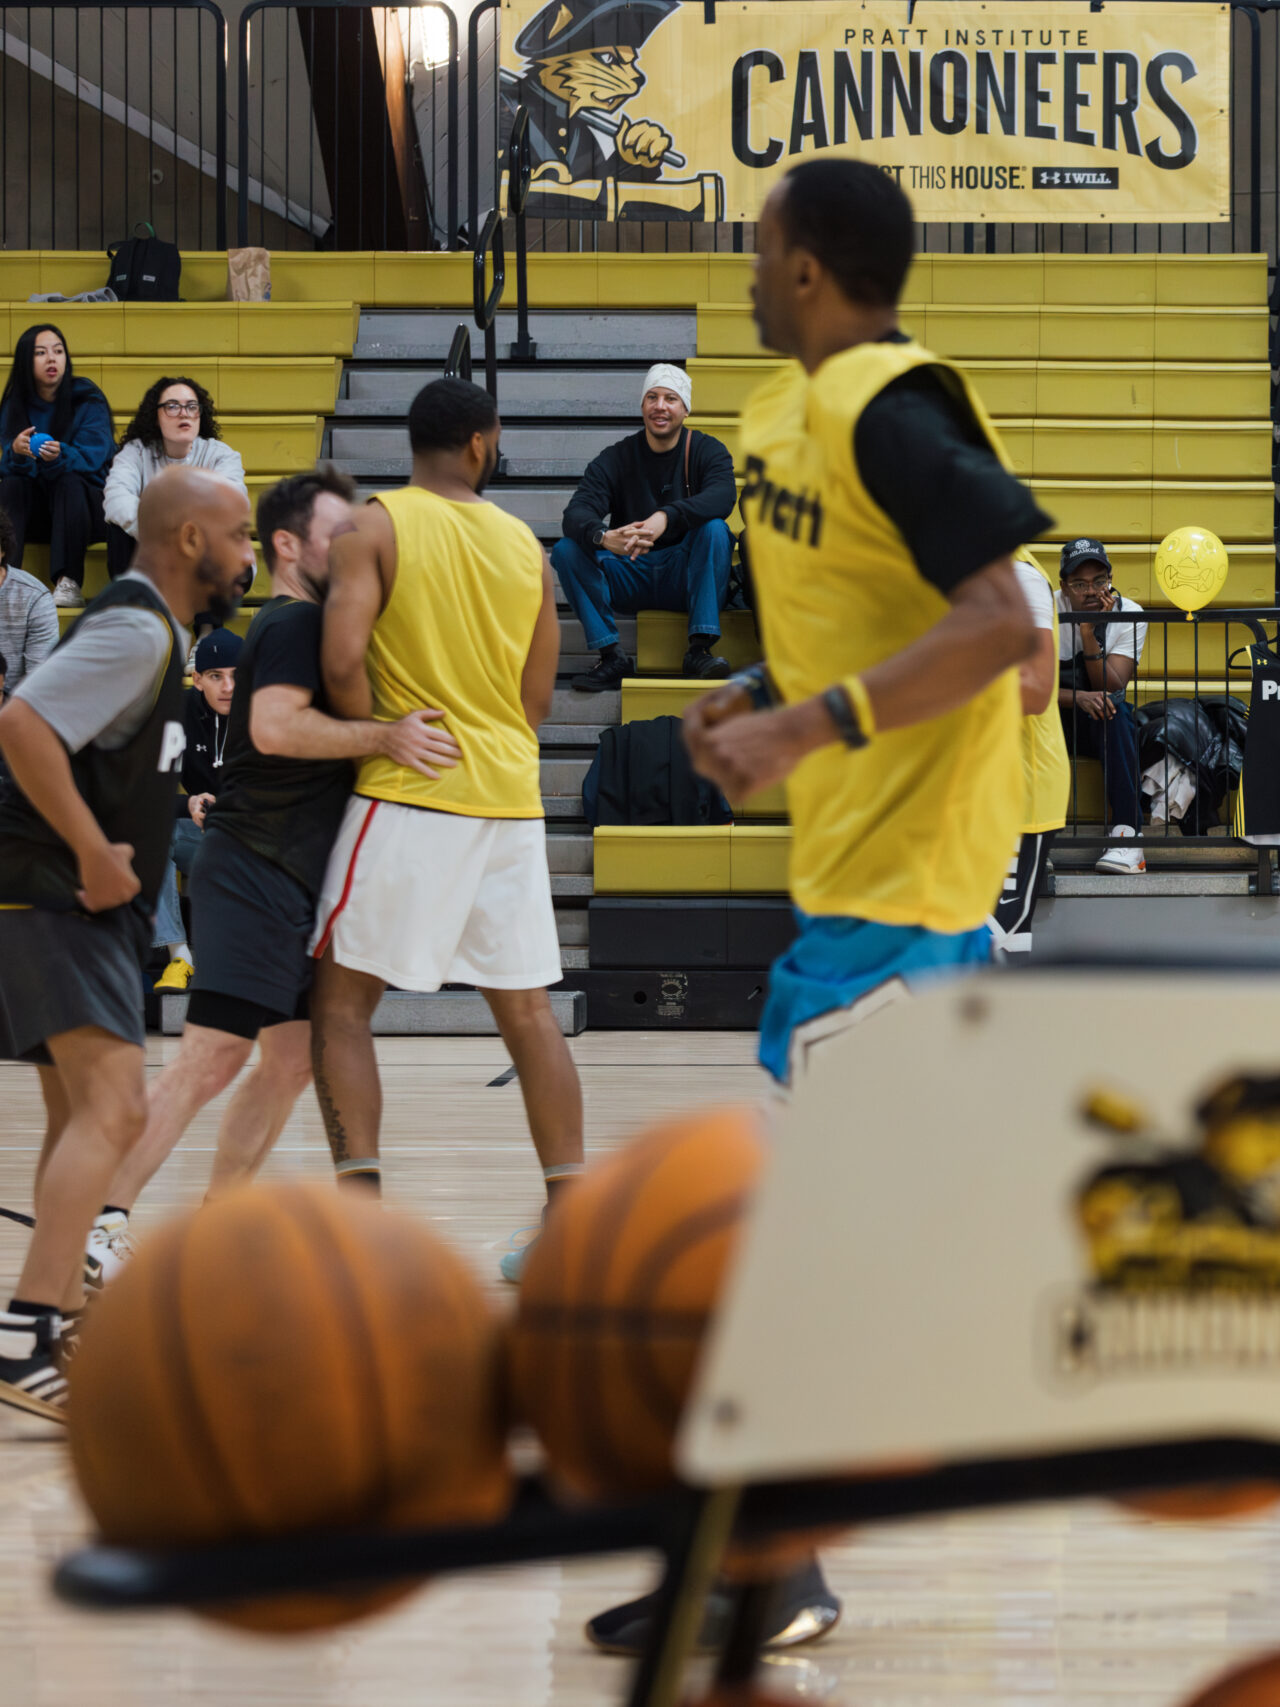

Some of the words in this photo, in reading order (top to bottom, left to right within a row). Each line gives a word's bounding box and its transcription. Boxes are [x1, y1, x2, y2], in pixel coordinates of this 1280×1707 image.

[845, 29, 928, 45] PRATT
[945, 29, 1088, 46] INSTITUTE
[732, 48, 1199, 170] CANNONEERS
[909, 165, 946, 189] THIS
[1064, 173, 1071, 184] I
